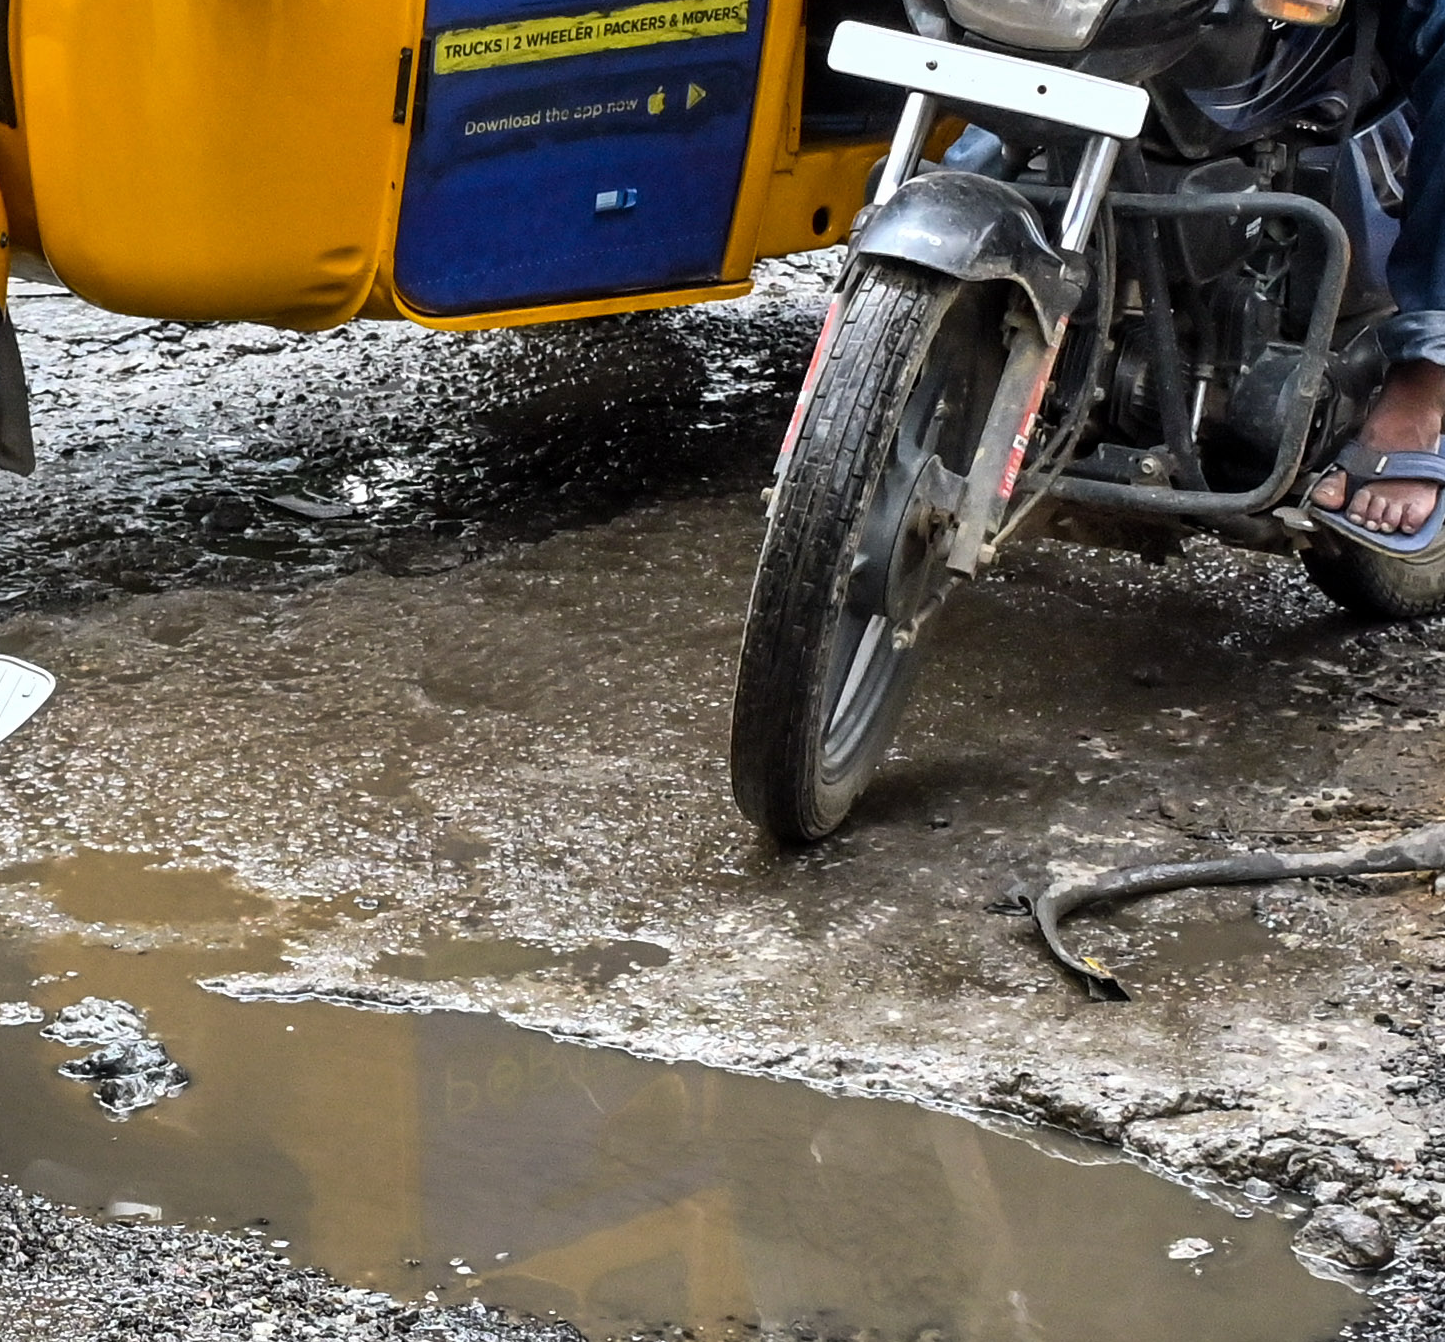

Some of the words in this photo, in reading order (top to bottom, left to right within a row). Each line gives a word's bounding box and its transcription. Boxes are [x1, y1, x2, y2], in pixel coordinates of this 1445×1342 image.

[444, 38, 503, 59] TRUCKS
[513, 35, 522, 50] 2
[526, 25, 594, 48] WHEELER
[603, 14, 666, 37] PACKERS
[669, 13, 679, 28] &
[682, 5, 740, 26] MOVERS
[464, 111, 541, 136] Download
[545, 107, 570, 123] the
[573, 103, 603, 119] app
[606, 99, 639, 114] now
